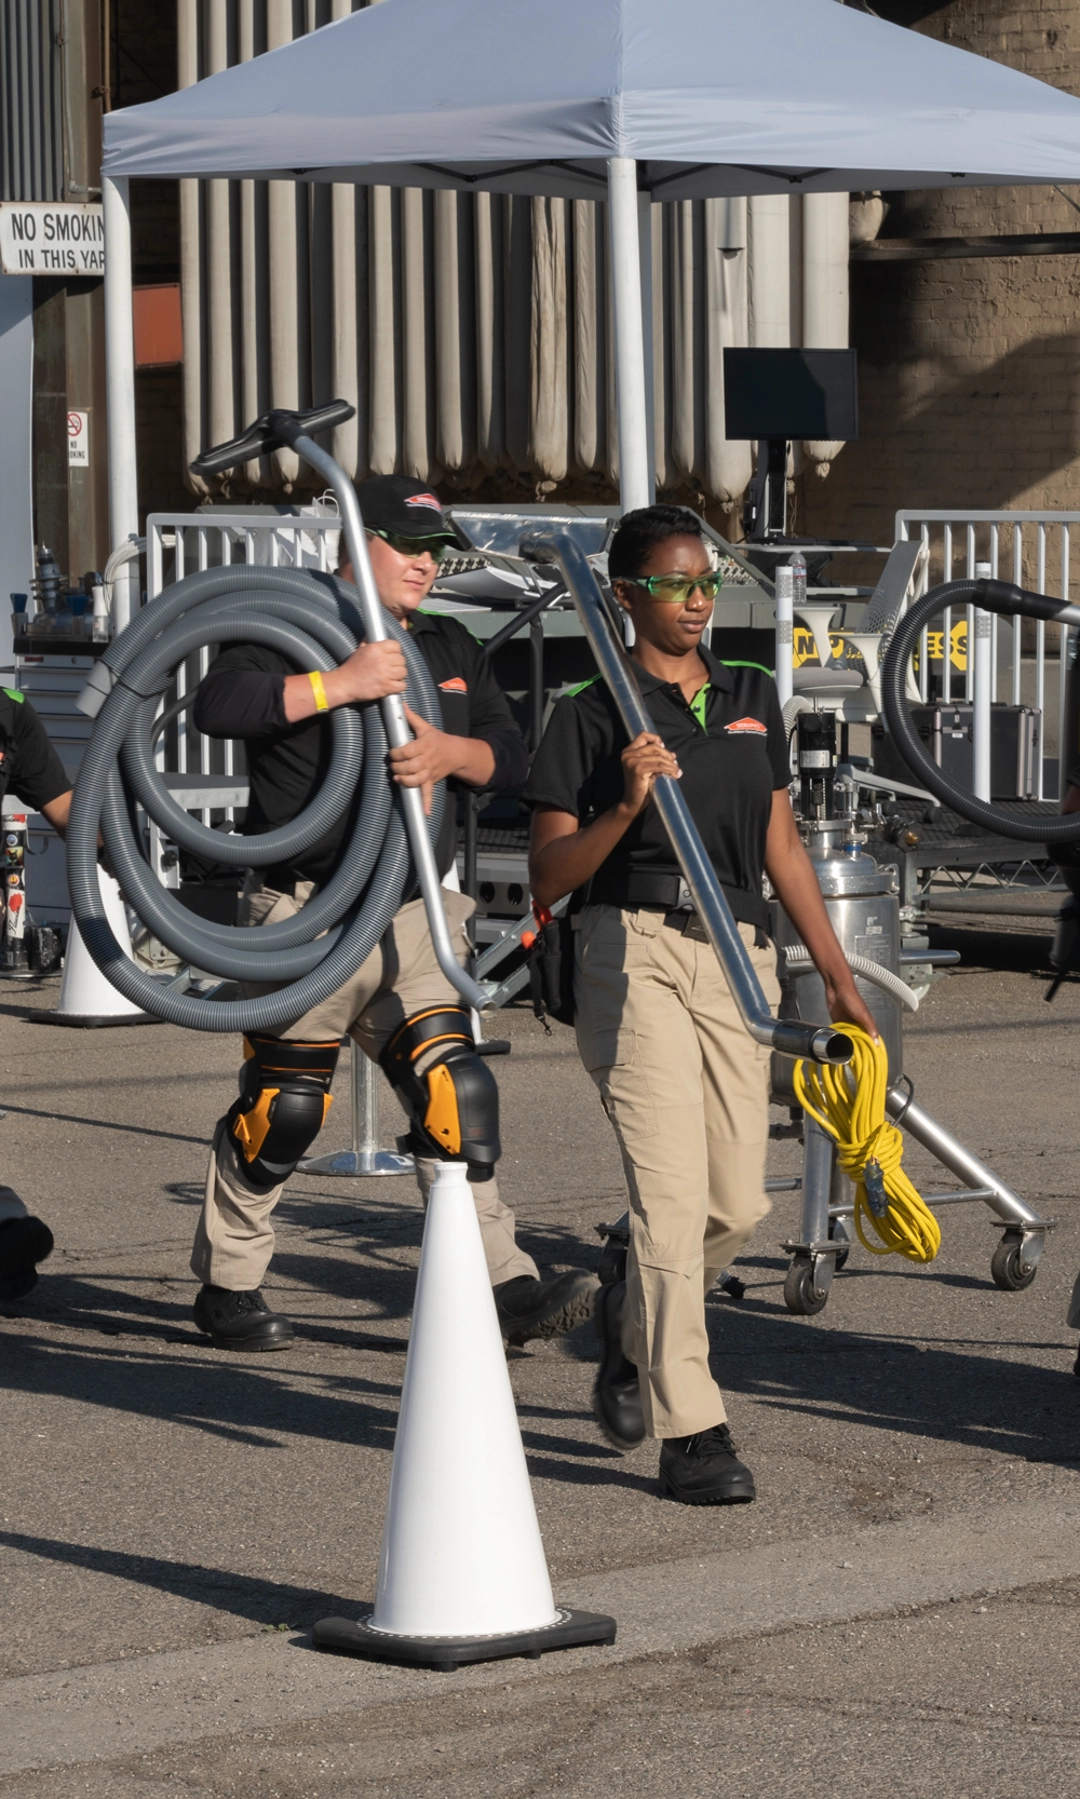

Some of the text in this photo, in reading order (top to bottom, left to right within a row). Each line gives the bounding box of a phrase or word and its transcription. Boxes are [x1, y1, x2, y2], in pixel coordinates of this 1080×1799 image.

[11, 213, 105, 242] NO SMOKIN
[19, 249, 105, 269] IN THIS YAR
[70, 441, 77, 449] NO
[69, 450, 85, 459] OKING
